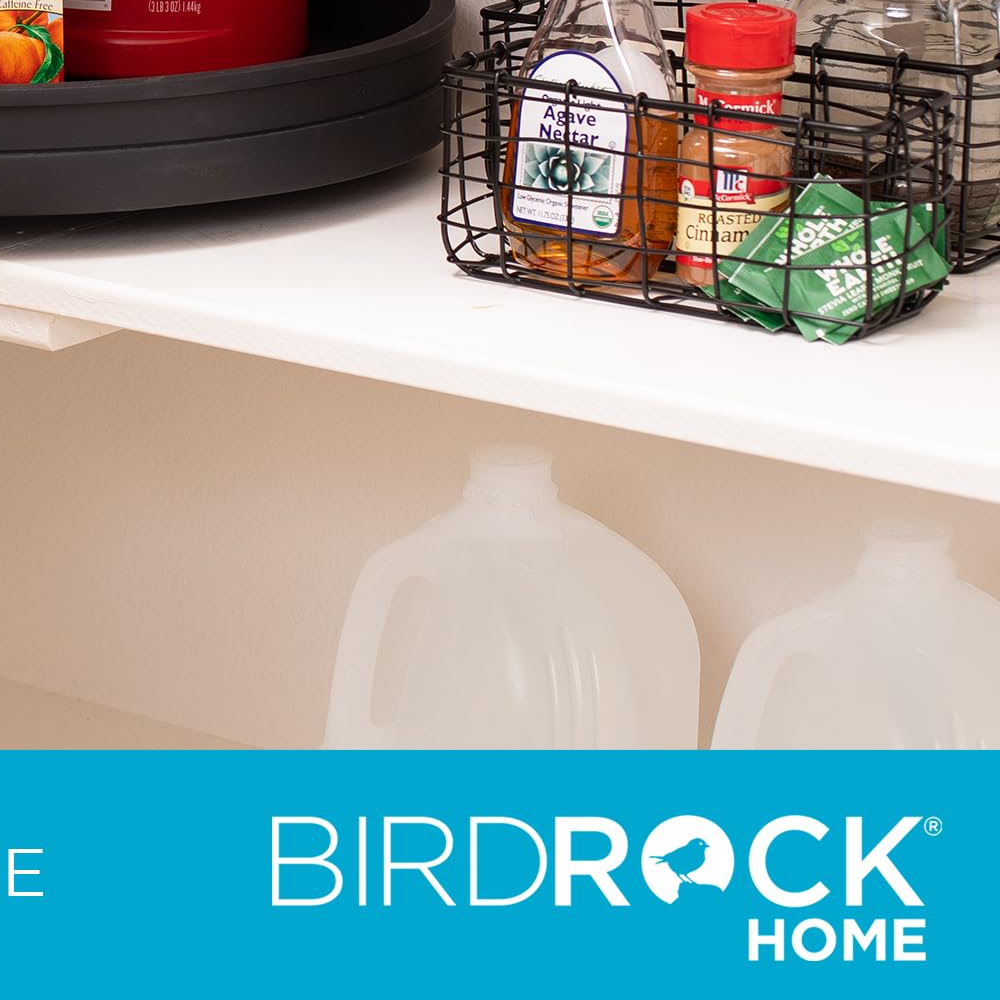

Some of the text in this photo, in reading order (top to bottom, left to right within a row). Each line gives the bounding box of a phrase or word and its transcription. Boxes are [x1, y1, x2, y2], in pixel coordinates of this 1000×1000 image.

[34, 0, 54, 11] Free
[148, 0, 202, 14] (3 LB 3 OZ) 1.44kg
[698, 94, 776, 114] MCormick
[544, 105, 597, 127] Agave
[715, 193, 752, 202] cCormick
[818, 295, 847, 315] STEVIA
